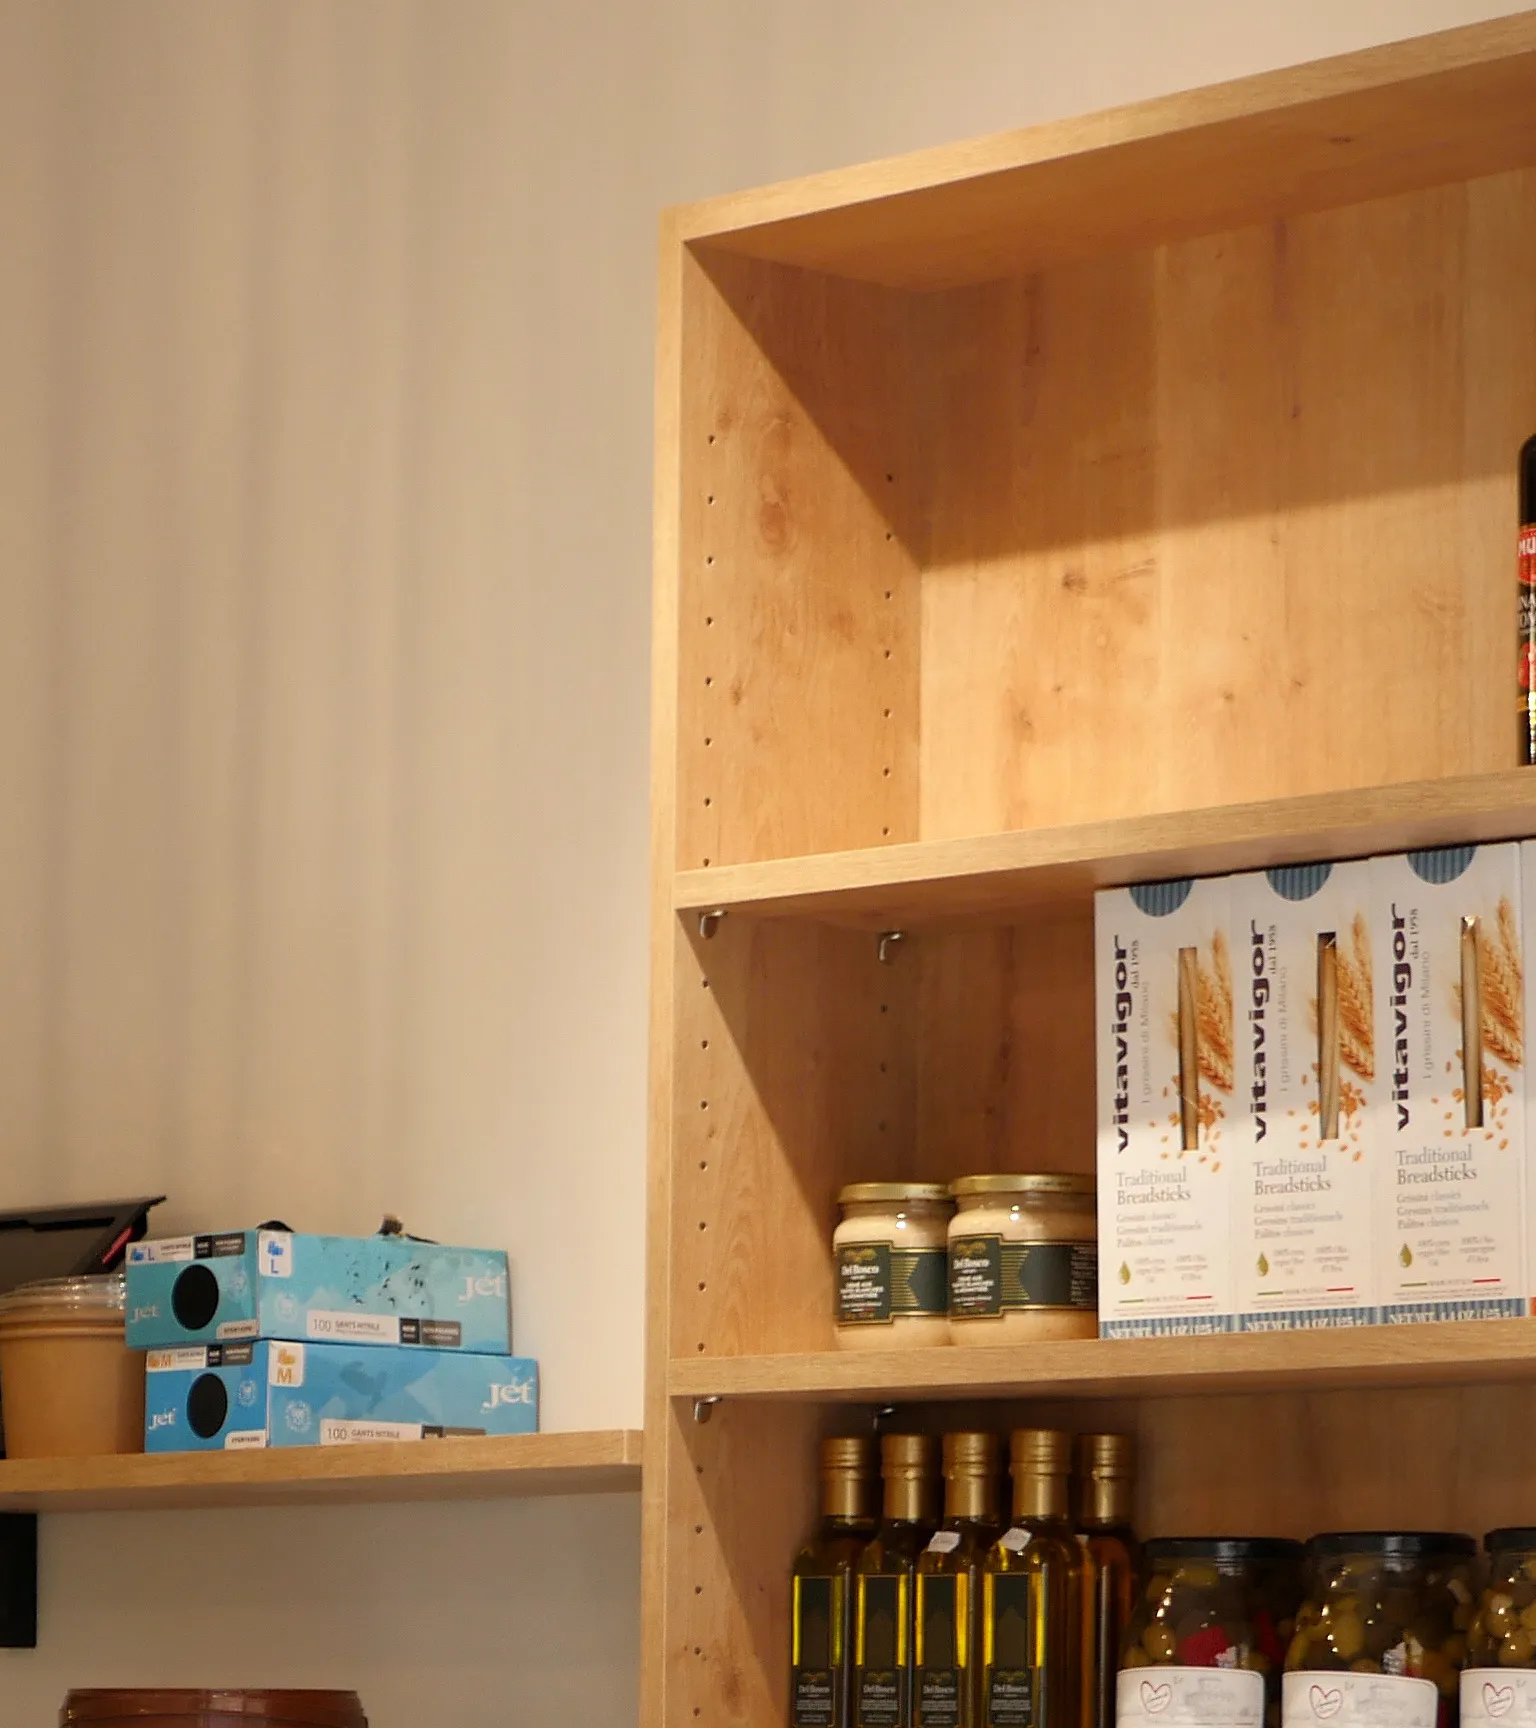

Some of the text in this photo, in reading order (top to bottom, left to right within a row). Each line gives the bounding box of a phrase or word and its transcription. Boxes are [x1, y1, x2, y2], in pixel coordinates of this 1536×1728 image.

[1268, 925, 1277, 975] dal 1958
[1410, 939, 1419, 959] dal
[1390, 903, 1412, 1131] vitavigor
[1249, 919, 1269, 1142] vitavigor
[1113, 934, 1132, 1153] vitavigor
[1396, 1144, 1473, 1166] Traditional
[1115, 1166, 1187, 1187] Traditional
[1252, 1155, 1327, 1177] Traditional
[1396, 1163, 1478, 1185] Breadsticks
[1117, 1185, 1191, 1206] Breadsticks
[1254, 1175, 1332, 1196] Breadsticks
[271, 1259, 279, 1274] L
[457, 1269, 507, 1305] jet
[313, 1318, 332, 1332] 100
[277, 1369, 292, 1384] M
[481, 1376, 535, 1414] jet
[149, 1409, 176, 1430] jet
[327, 1428, 346, 1440] 100
